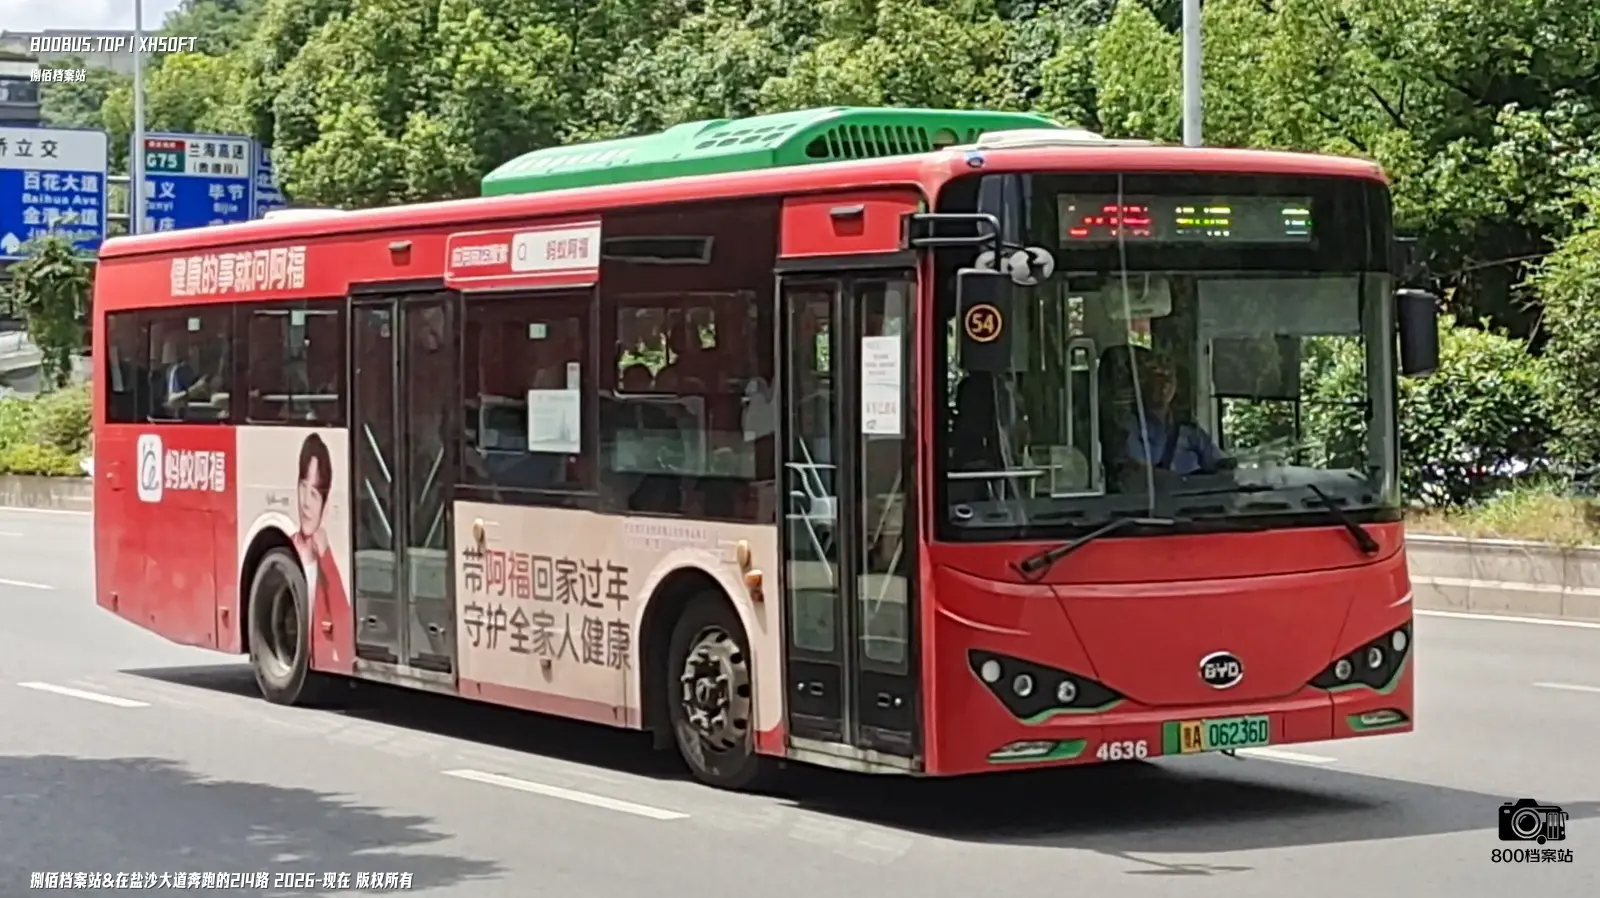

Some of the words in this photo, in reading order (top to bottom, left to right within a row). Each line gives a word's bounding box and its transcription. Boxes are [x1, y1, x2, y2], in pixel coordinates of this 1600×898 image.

[147, 153, 178, 168] G75
[189, 142, 244, 159] 兰海高速
[24, 171, 98, 193] 百花大道
[208, 183, 245, 201] 毕节
[22, 192, 69, 205] Baihua
[170, 246, 307, 297] 健康的事就问阿福
[970, 312, 995, 333] 54
[164, 448, 226, 493] 蚂蚁阿福
[462, 546, 630, 611] 带阿福回家过年
[464, 600, 632, 670] 守护全家人健康
[1204, 660, 1239, 680] BYD
[1209, 719, 1268, 747] 06236D
[1096, 739, 1148, 761] 4636
